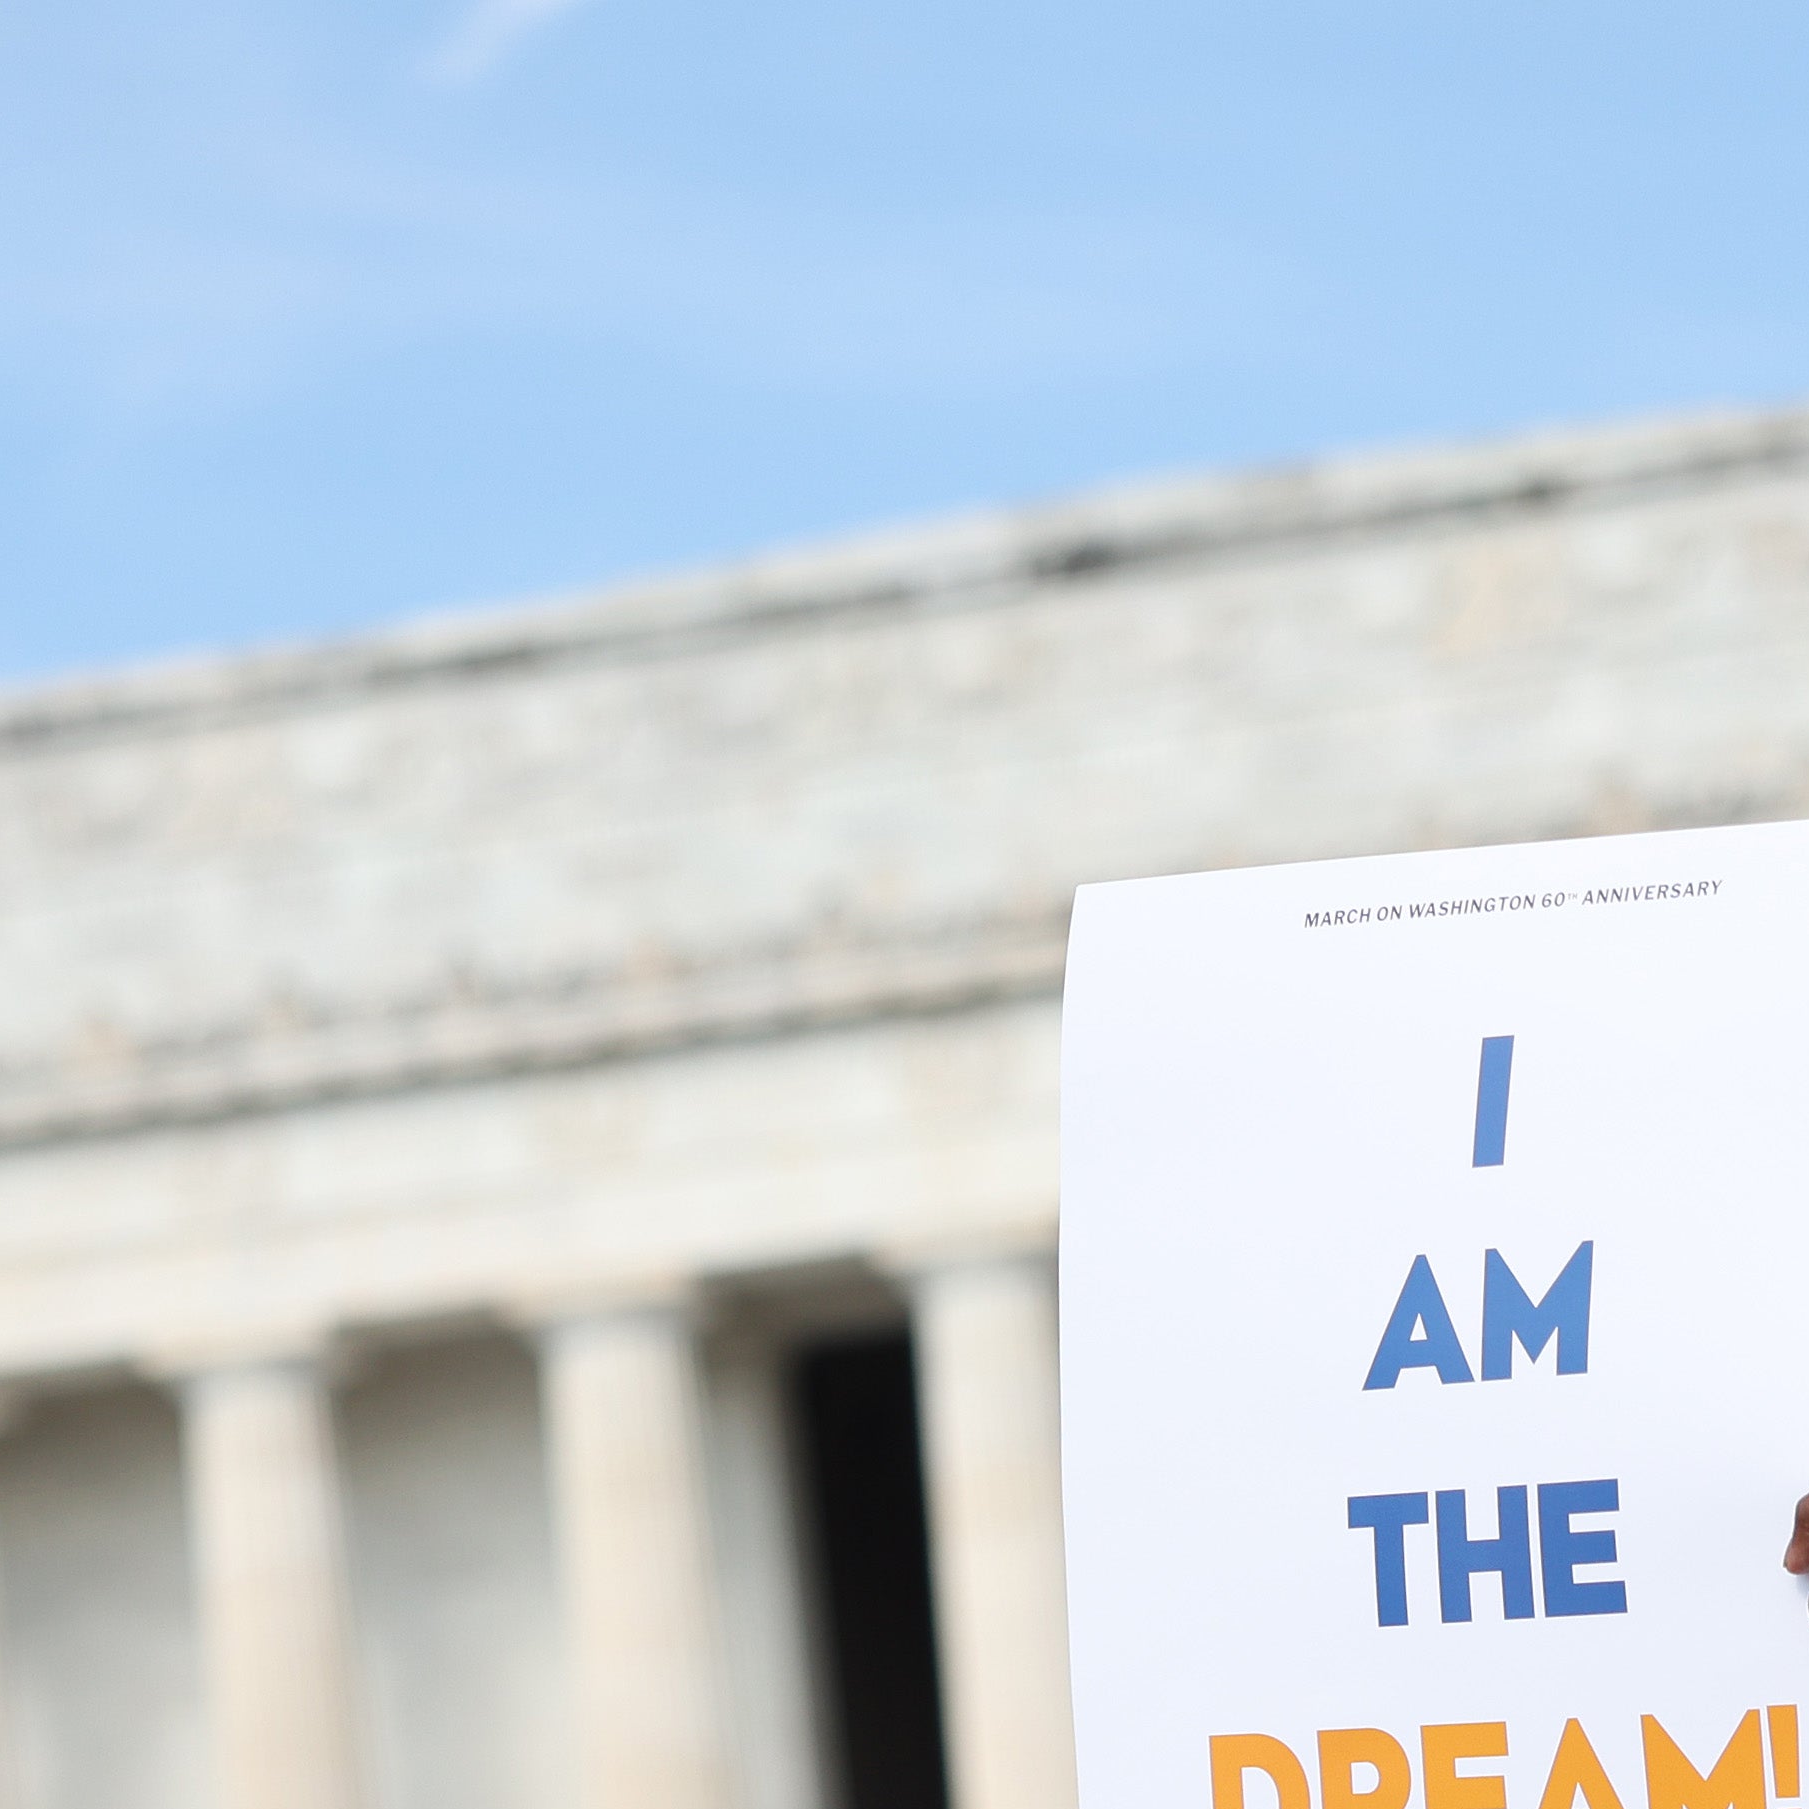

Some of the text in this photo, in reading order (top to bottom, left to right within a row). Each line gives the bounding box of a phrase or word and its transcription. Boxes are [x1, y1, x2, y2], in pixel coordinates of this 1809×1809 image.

[1304, 908, 1371, 928] MARCH
[1377, 905, 1403, 922] ON
[1410, 894, 1536, 918] WASHINGTON
[1582, 880, 1722, 904] ANNIVERSARY
[1473, 1035, 1515, 1168] I
[1362, 1240, 1594, 1391] AM
[1347, 1478, 1628, 1628] THE
